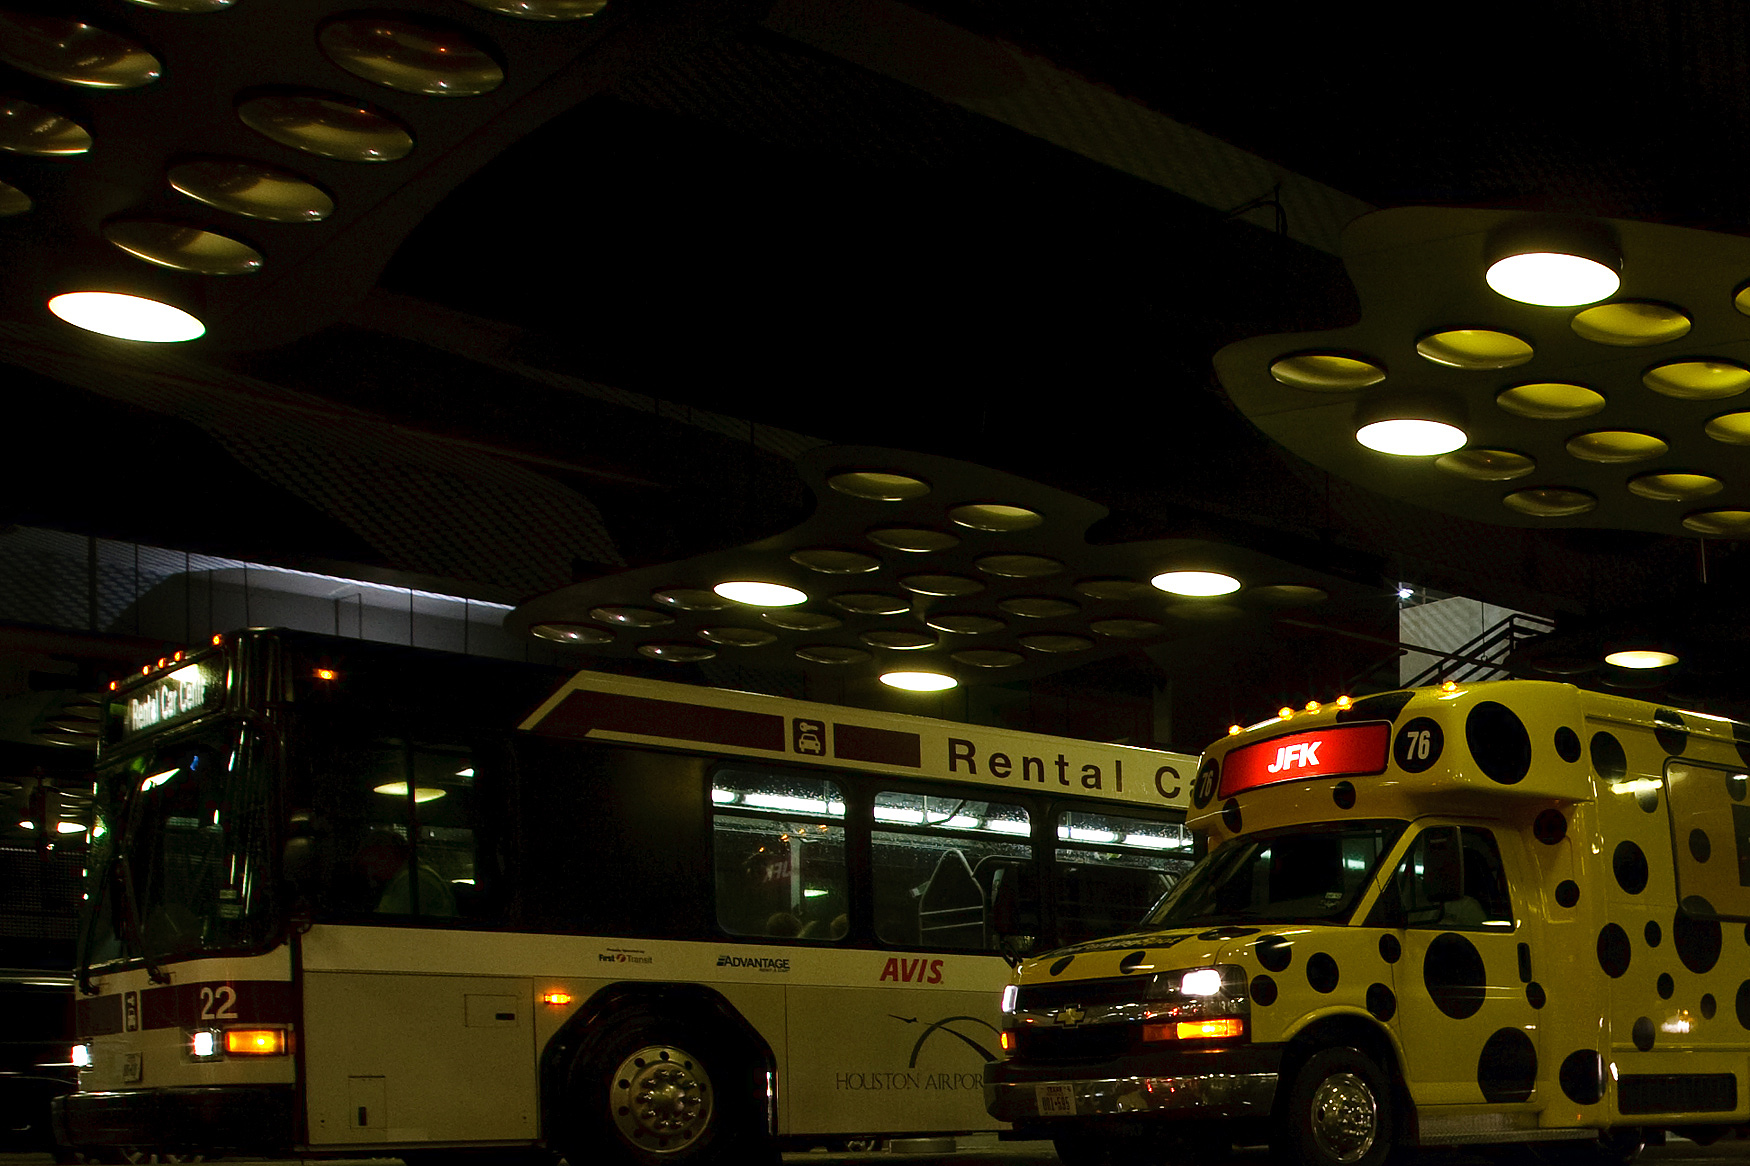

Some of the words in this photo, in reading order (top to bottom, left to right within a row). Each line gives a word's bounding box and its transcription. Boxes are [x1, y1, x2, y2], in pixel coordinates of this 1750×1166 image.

[1267, 740, 1323, 774] JFK
[1406, 730, 1431, 761] 76
[948, 737, 1123, 793] Rental
[1198, 769, 1214, 799] 76
[626, 954, 653, 964] Transit
[724, 955, 790, 969] ADVANTAGE
[880, 957, 944, 984] AVIS
[200, 986, 239, 1020] 22
[836, 1073, 920, 1090] HOUSTON
